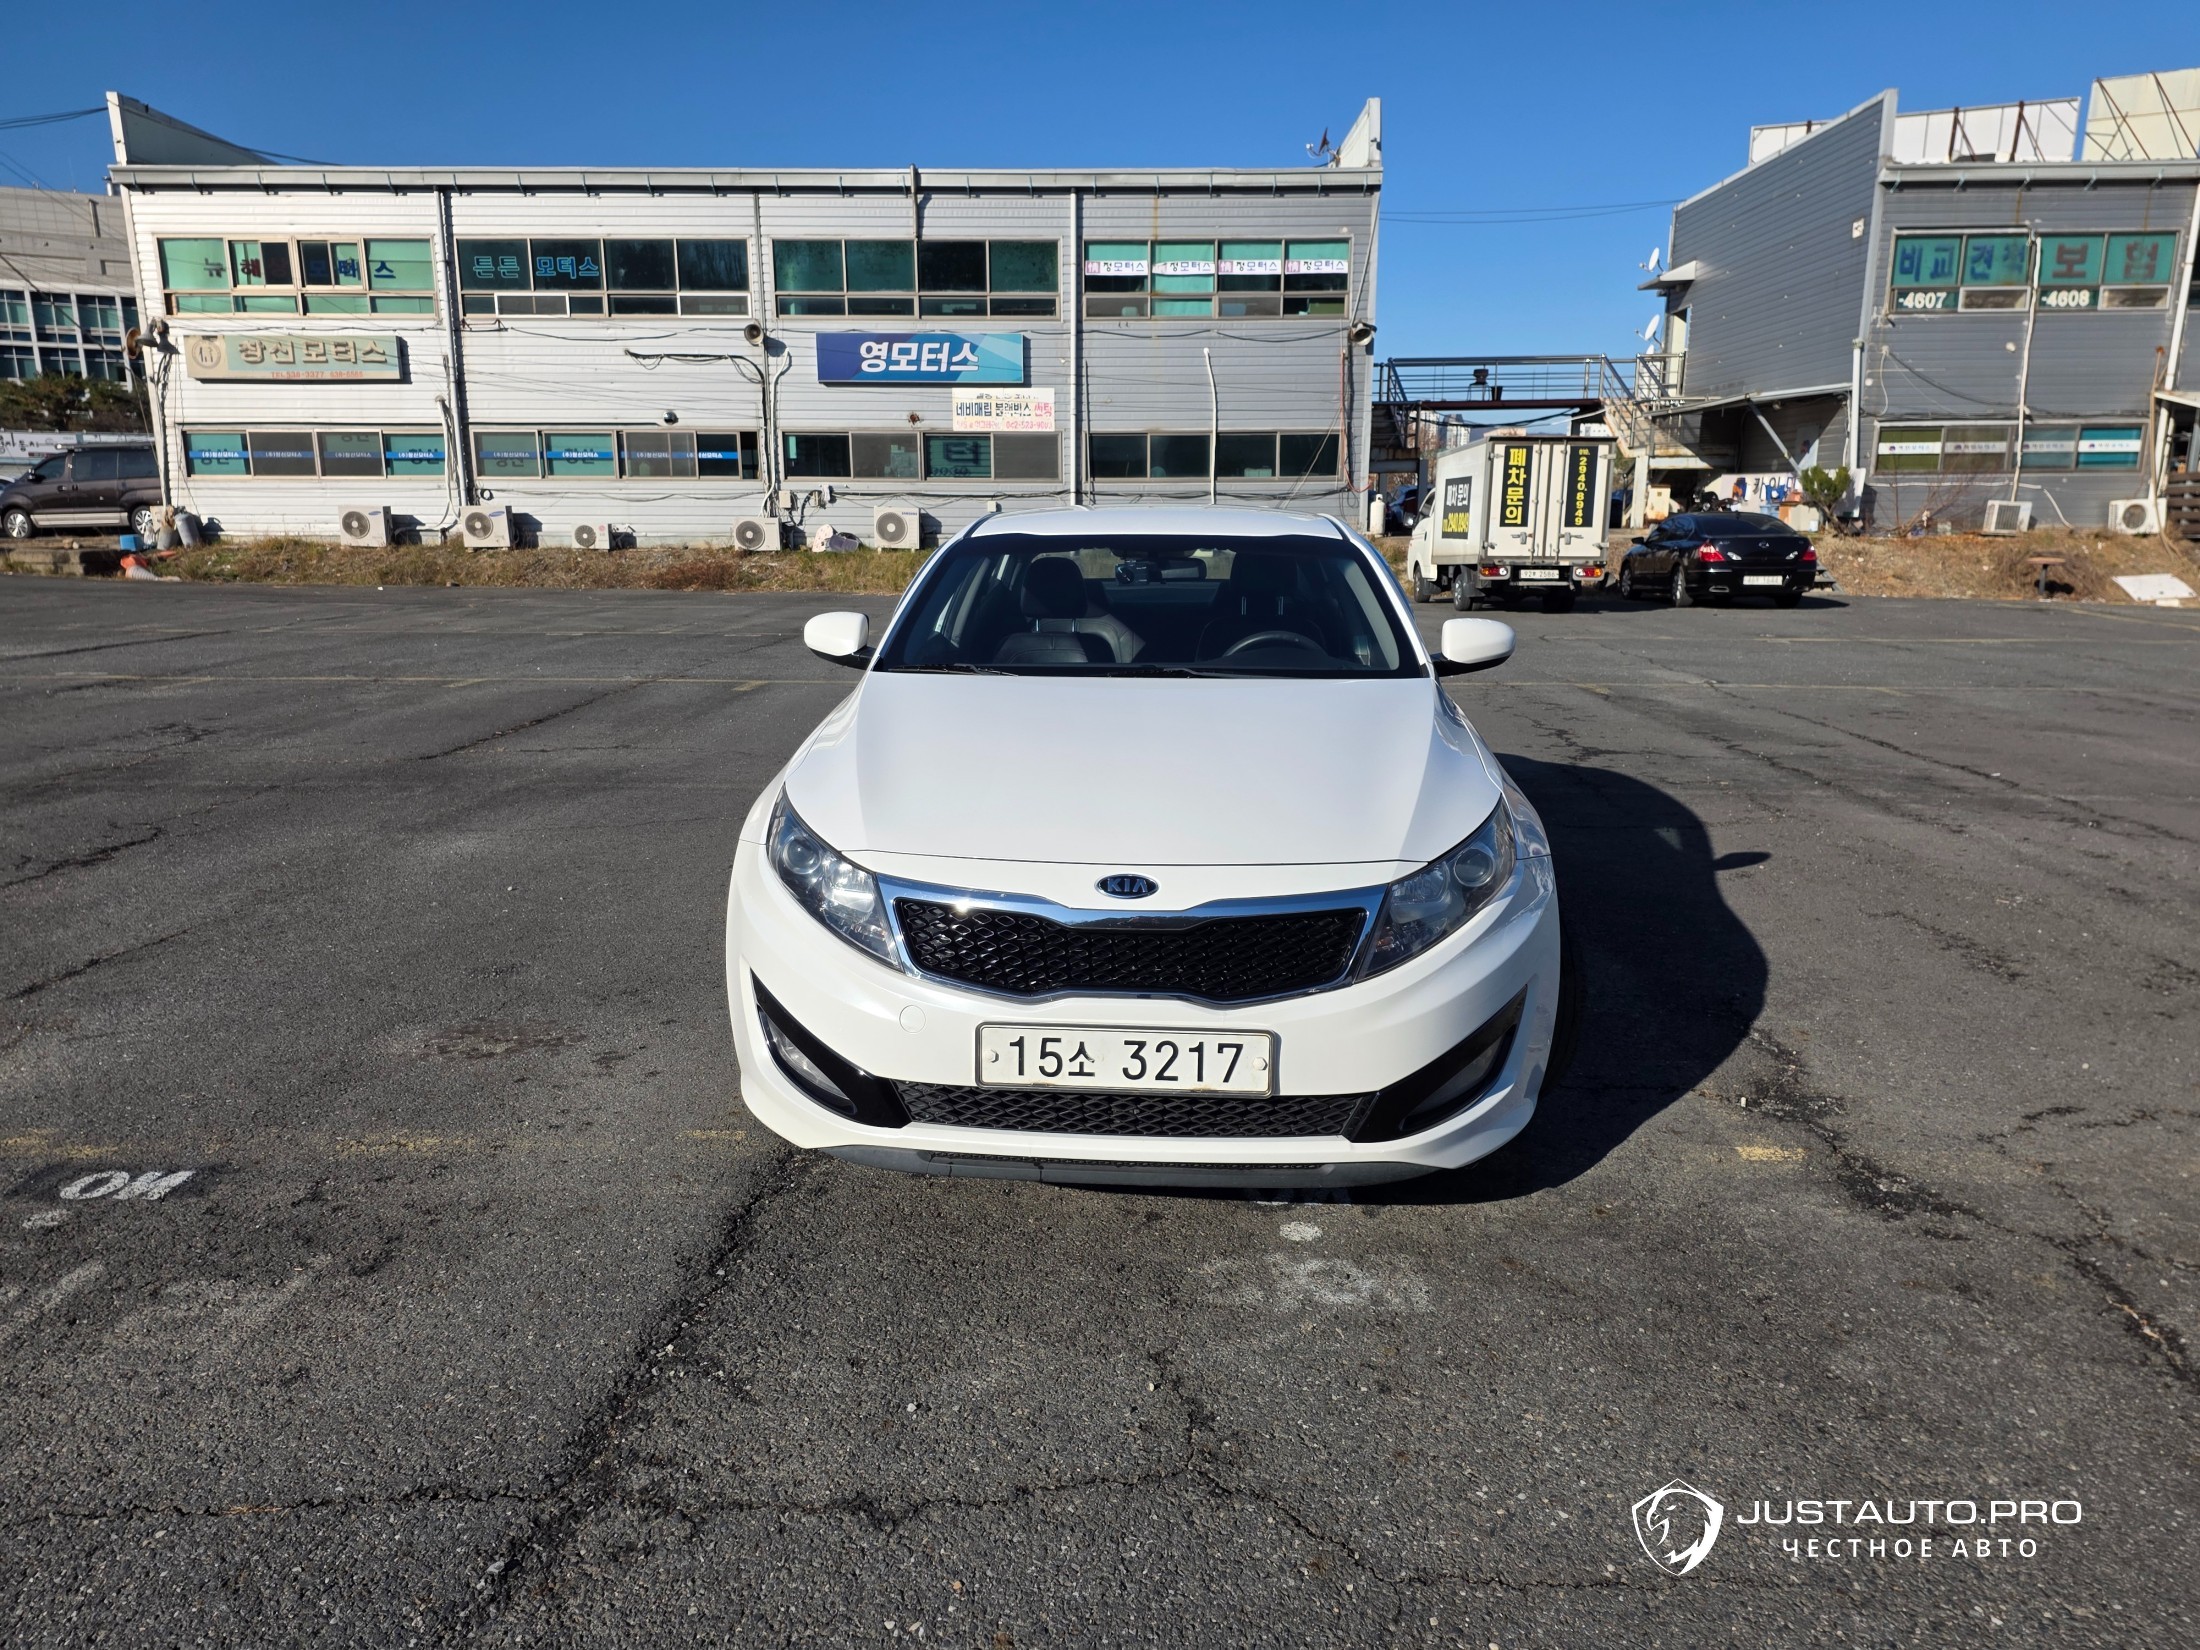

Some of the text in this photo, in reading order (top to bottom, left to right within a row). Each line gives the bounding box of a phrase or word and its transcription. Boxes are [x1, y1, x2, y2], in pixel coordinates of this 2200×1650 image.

[473, 256, 600, 279] 튼튼 모터스
[860, 341, 979, 373] 영모터스
[956, 402, 992, 417] 네비매립
[1504, 448, 1527, 525] 폐차문의
[1107, 878, 1148, 893] KIA
[1009, 1035, 1244, 1083] 15소 3217
